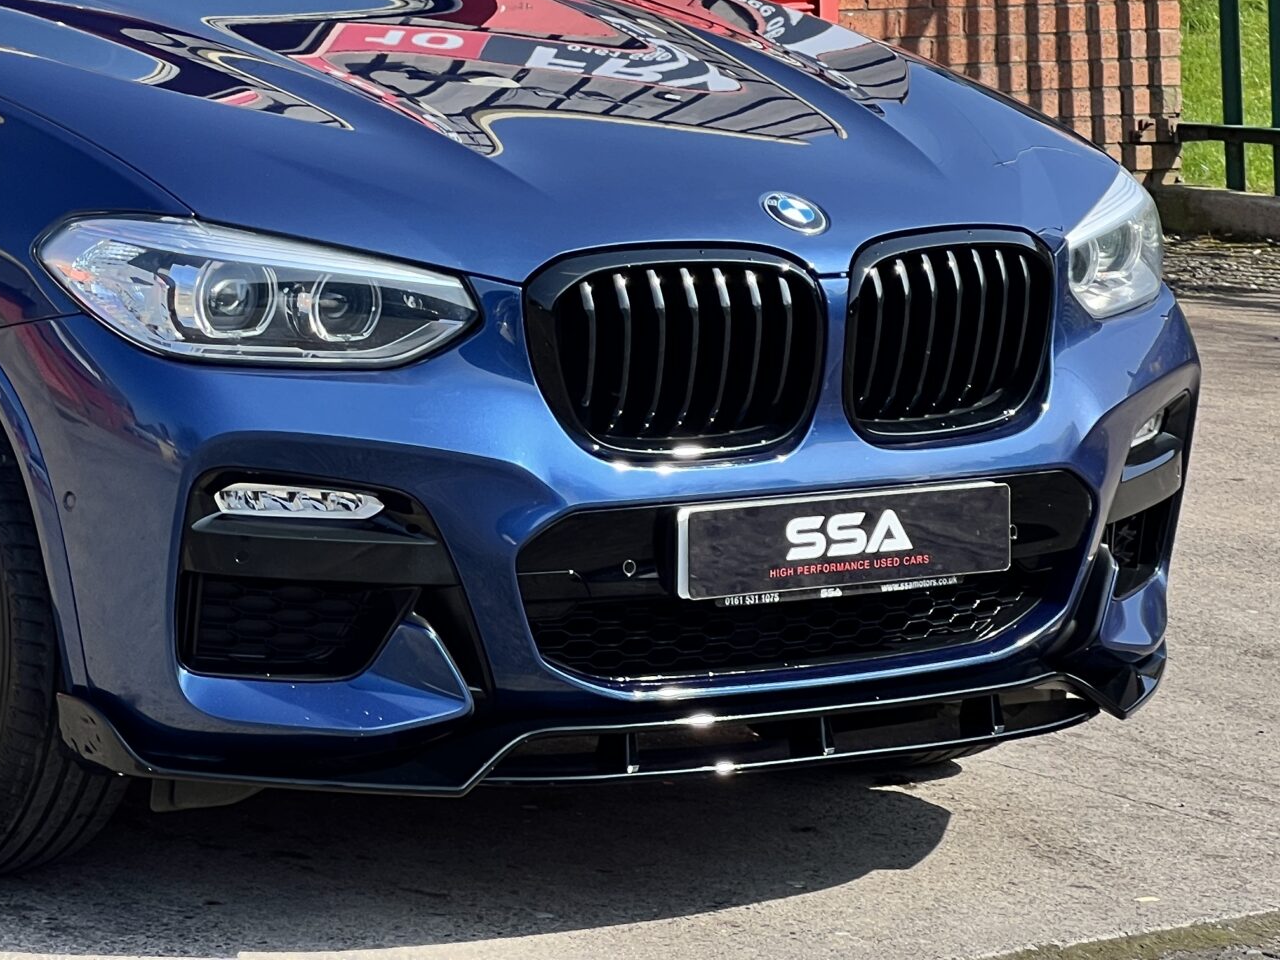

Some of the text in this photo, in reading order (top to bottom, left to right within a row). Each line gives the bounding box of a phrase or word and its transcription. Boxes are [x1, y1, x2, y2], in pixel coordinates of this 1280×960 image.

[785, 508, 914, 561] SSA
[769, 554, 930, 578] HIGH PERFORMANCE USED CARS
[724, 596, 743, 606] 0161
